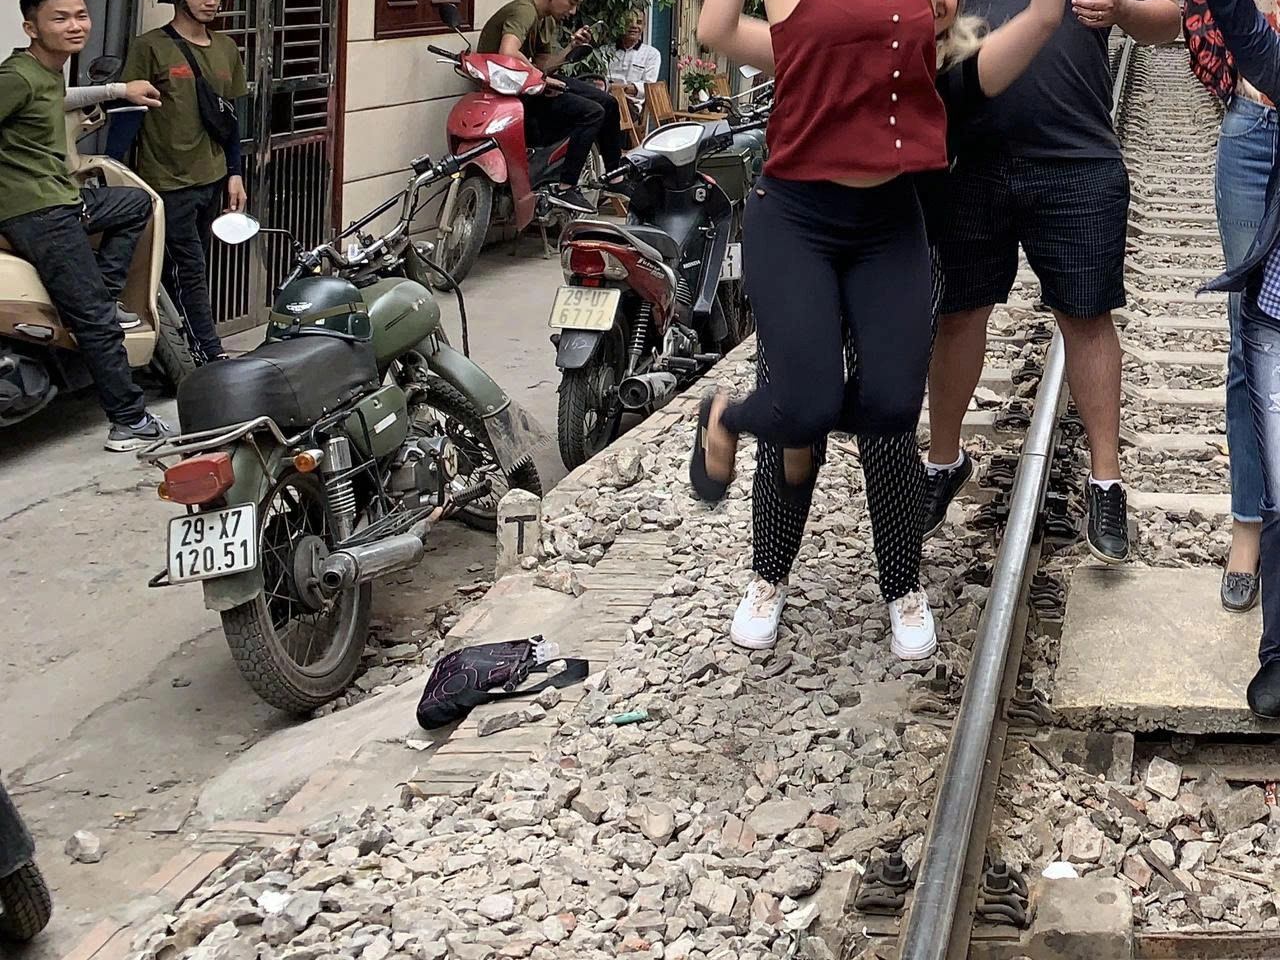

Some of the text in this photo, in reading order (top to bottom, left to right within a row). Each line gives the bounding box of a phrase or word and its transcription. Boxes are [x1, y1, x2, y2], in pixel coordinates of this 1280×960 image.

[563, 289, 610, 308] 29-U7
[559, 308, 605, 327] 6772
[181, 510, 242, 547] 29-X7
[505, 515, 537, 554] T
[175, 539, 248, 578] 120.51
